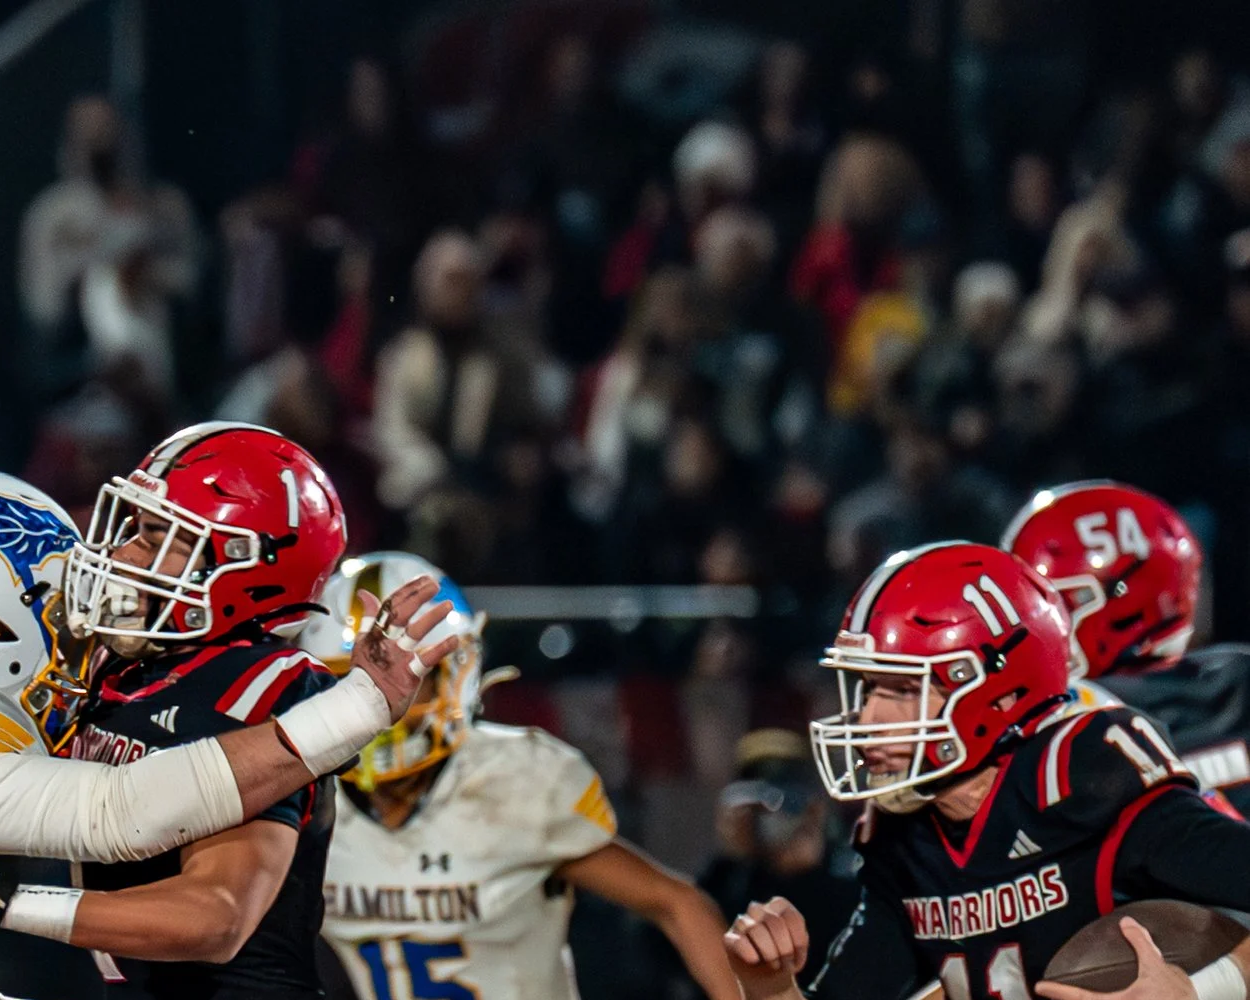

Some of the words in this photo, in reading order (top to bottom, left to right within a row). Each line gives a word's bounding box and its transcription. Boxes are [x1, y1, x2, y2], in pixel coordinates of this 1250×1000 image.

[280, 468, 299, 528] 1
[1073, 507, 1150, 569] 54
[962, 574, 1022, 638] 11
[1104, 715, 1190, 789] 11
[902, 863, 1069, 940] WARRIORS
